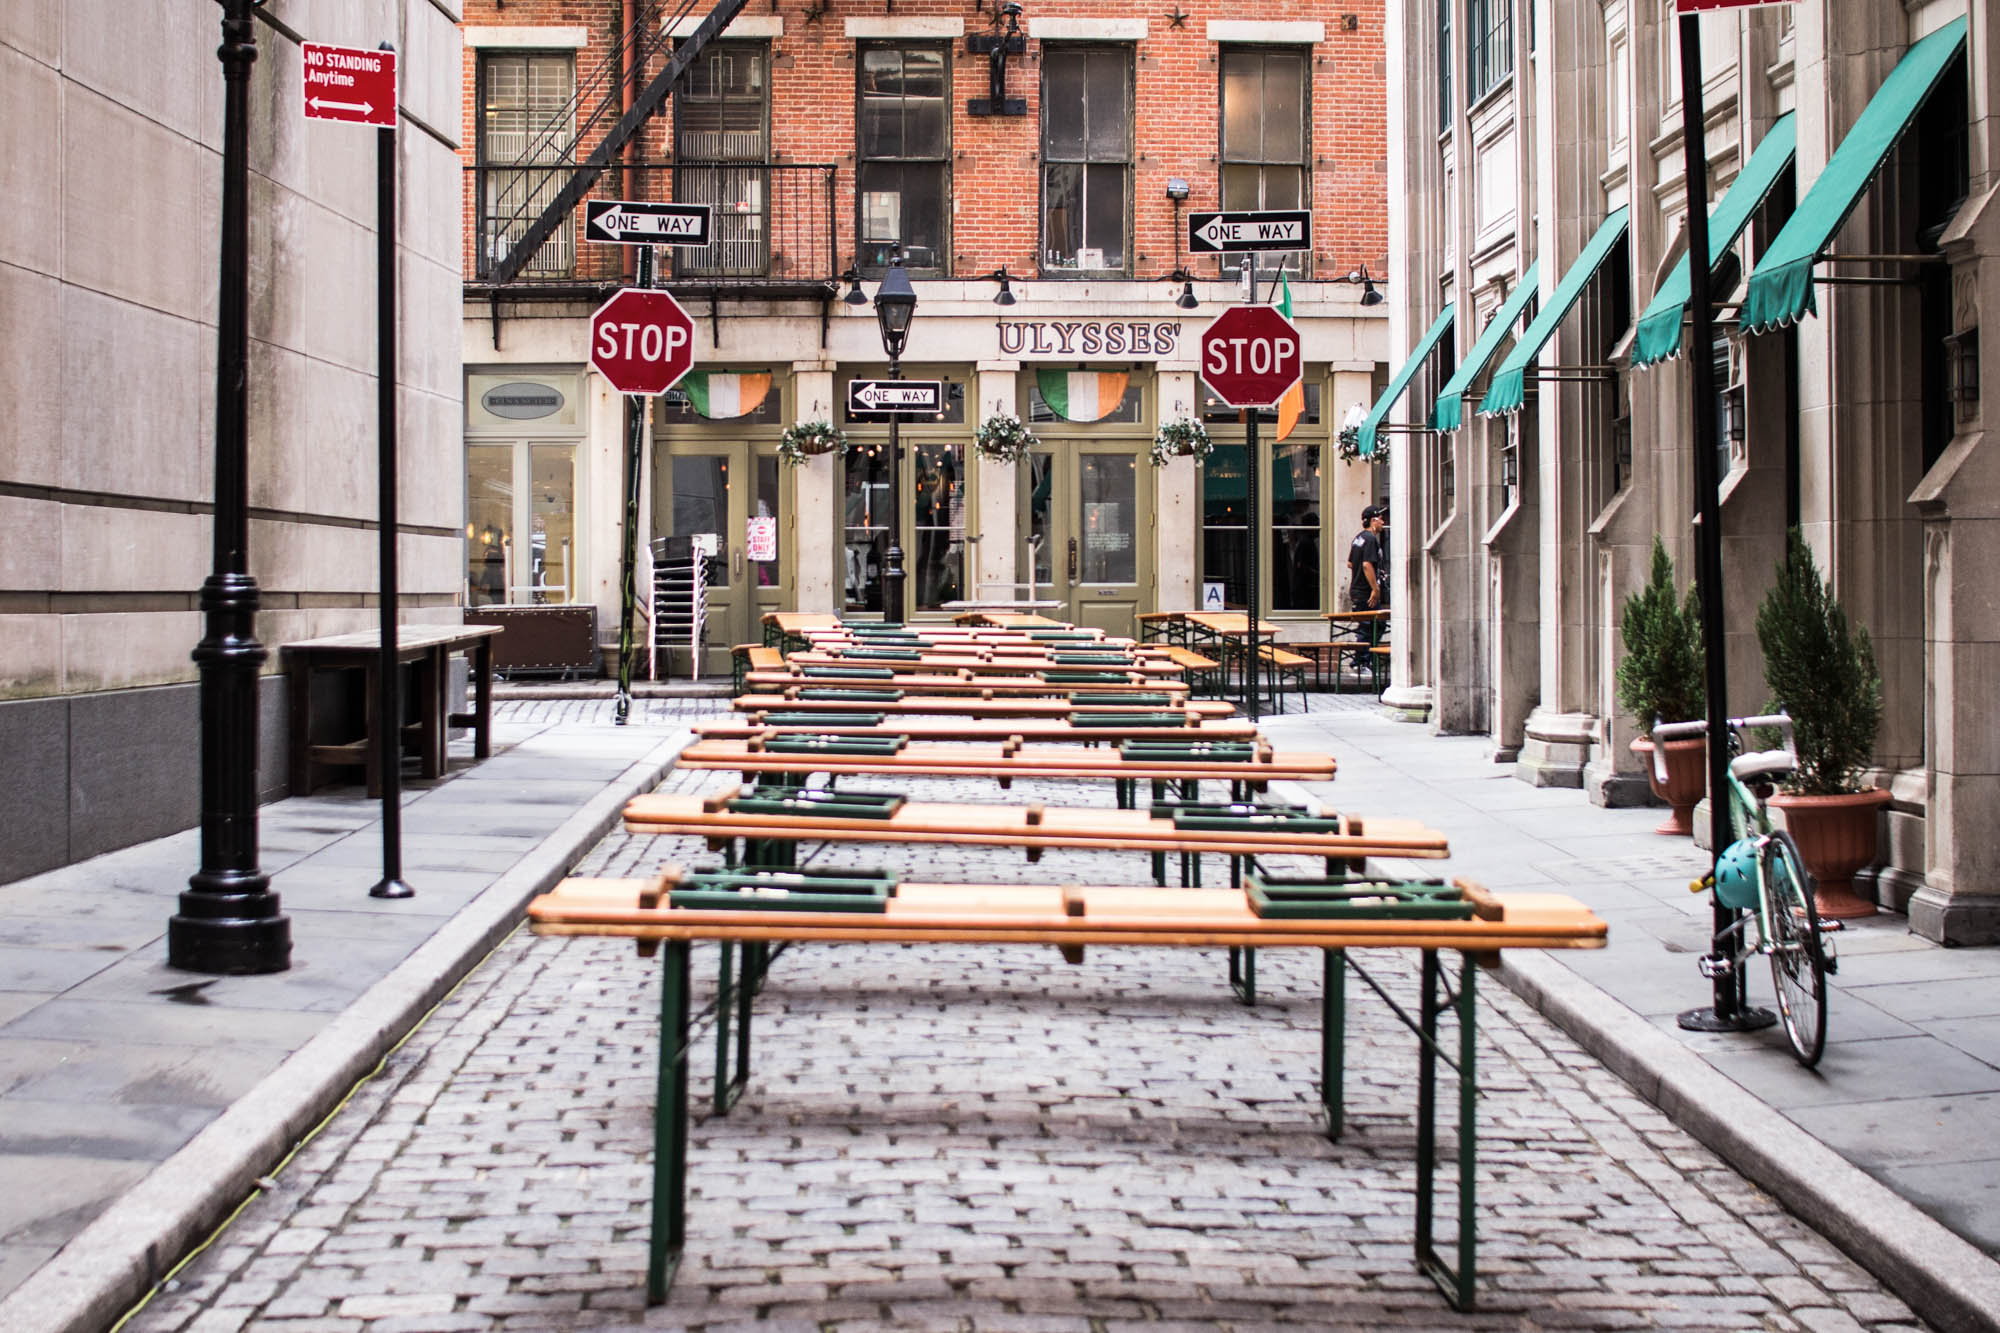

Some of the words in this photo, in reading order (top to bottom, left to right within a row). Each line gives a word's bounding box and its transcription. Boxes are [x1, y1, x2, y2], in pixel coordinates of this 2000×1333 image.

[308, 51, 324, 66] NO
[326, 53, 381, 72] STANDING
[308, 68, 354, 87] Anytime
[606, 215, 640, 231] ONE
[657, 217, 694, 233] WAY
[1208, 225, 1242, 240] ONE
[1258, 224, 1295, 239] WAY
[597, 322, 687, 362] STOP
[996, 322, 1181, 354] ULYSSES'
[1207, 338, 1295, 375] STOP
[864, 390, 889, 402] ONE
[902, 391, 928, 402] WAY
[752, 544, 769, 552] ONLY
[1207, 586, 1221, 603] A
